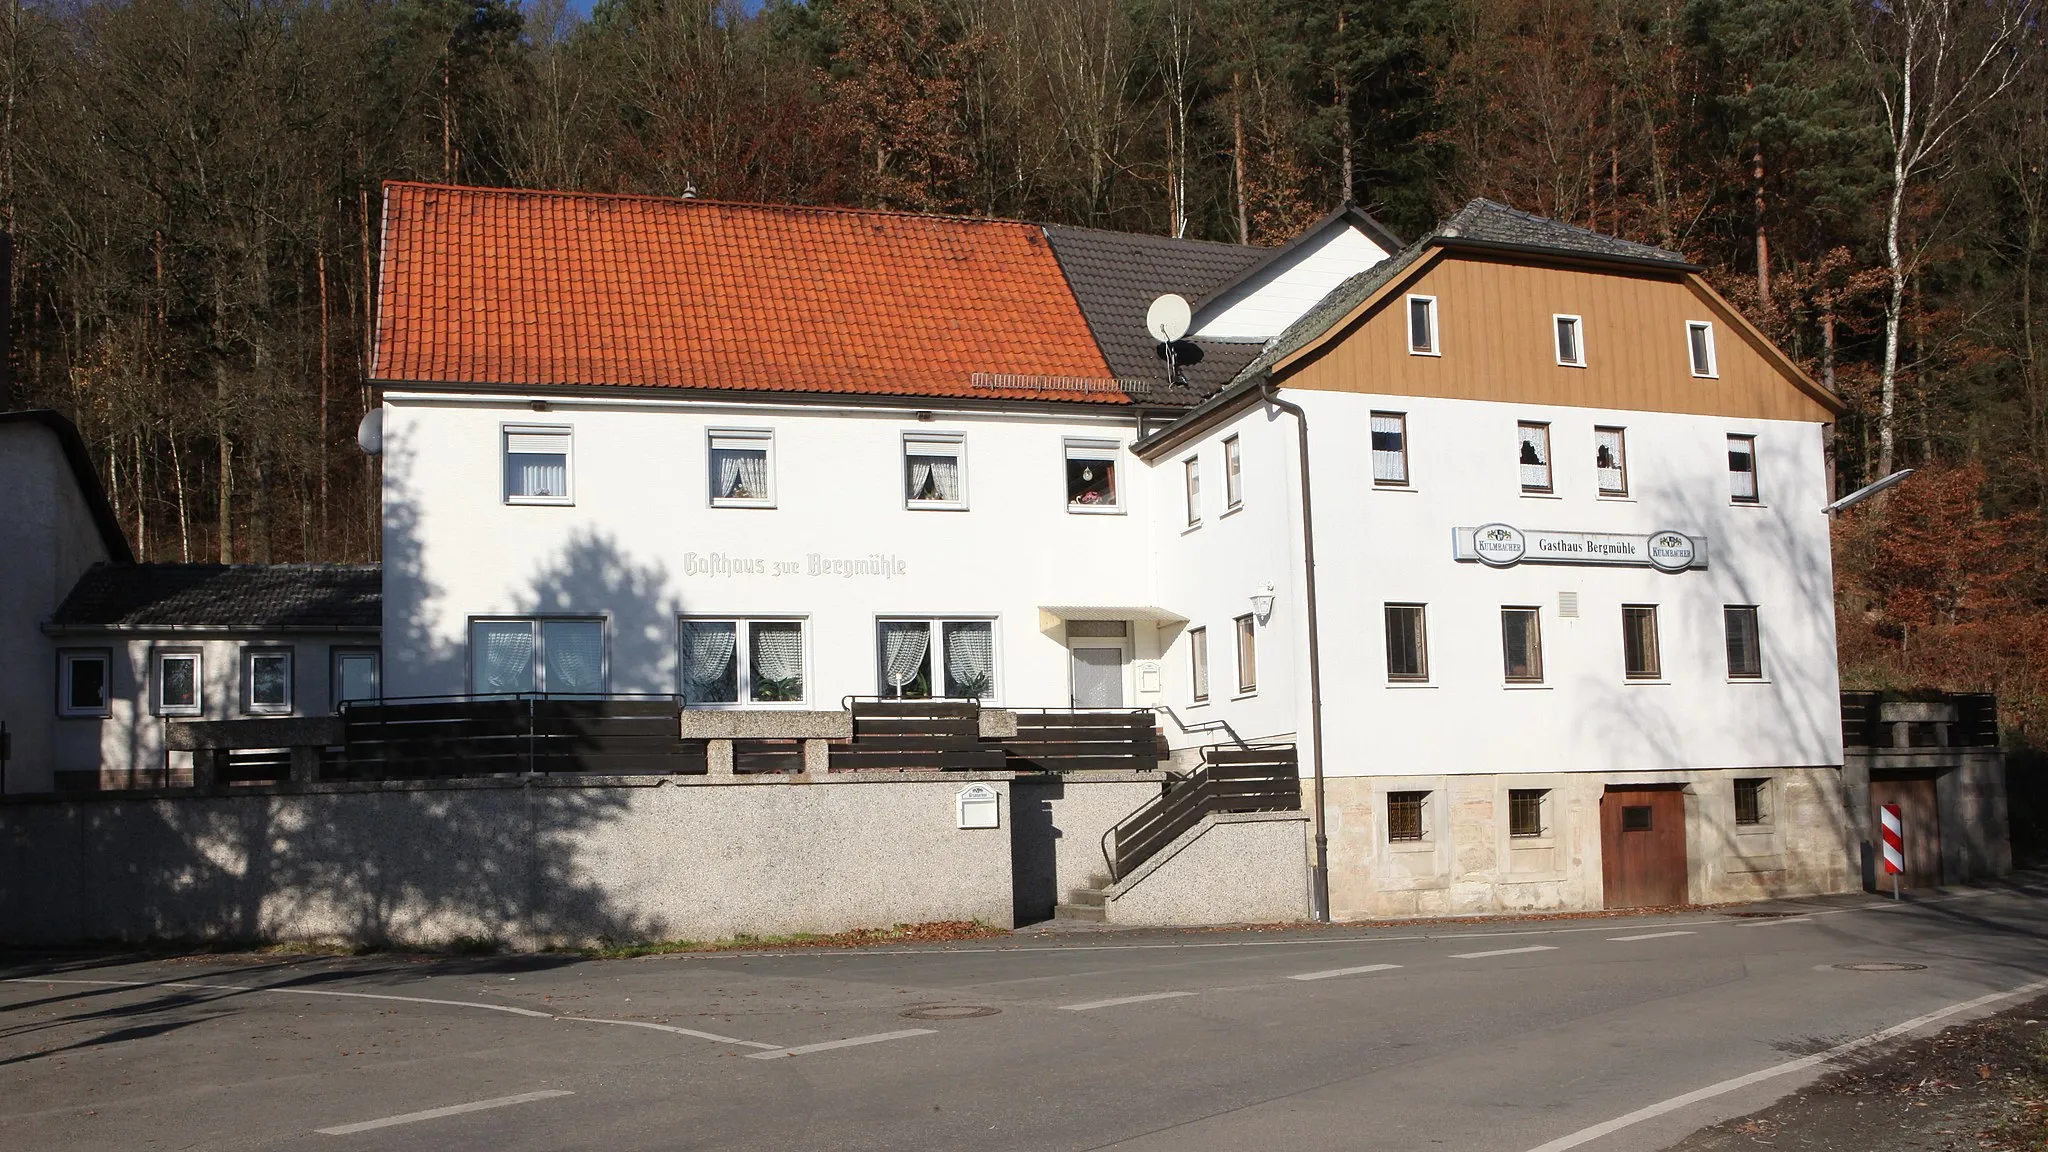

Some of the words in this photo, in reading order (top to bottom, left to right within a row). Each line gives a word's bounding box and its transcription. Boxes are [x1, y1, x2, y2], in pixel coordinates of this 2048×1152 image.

[1479, 540, 1521, 551] KULMBACHER
[1539, 538, 1583, 552] Gasthaus
[1587, 540, 1636, 555] Bergmühle
[1652, 547, 1691, 557] KULMBACHER
[771, 560, 800, 577] zur
[806, 552, 906, 579] Bergmühle
